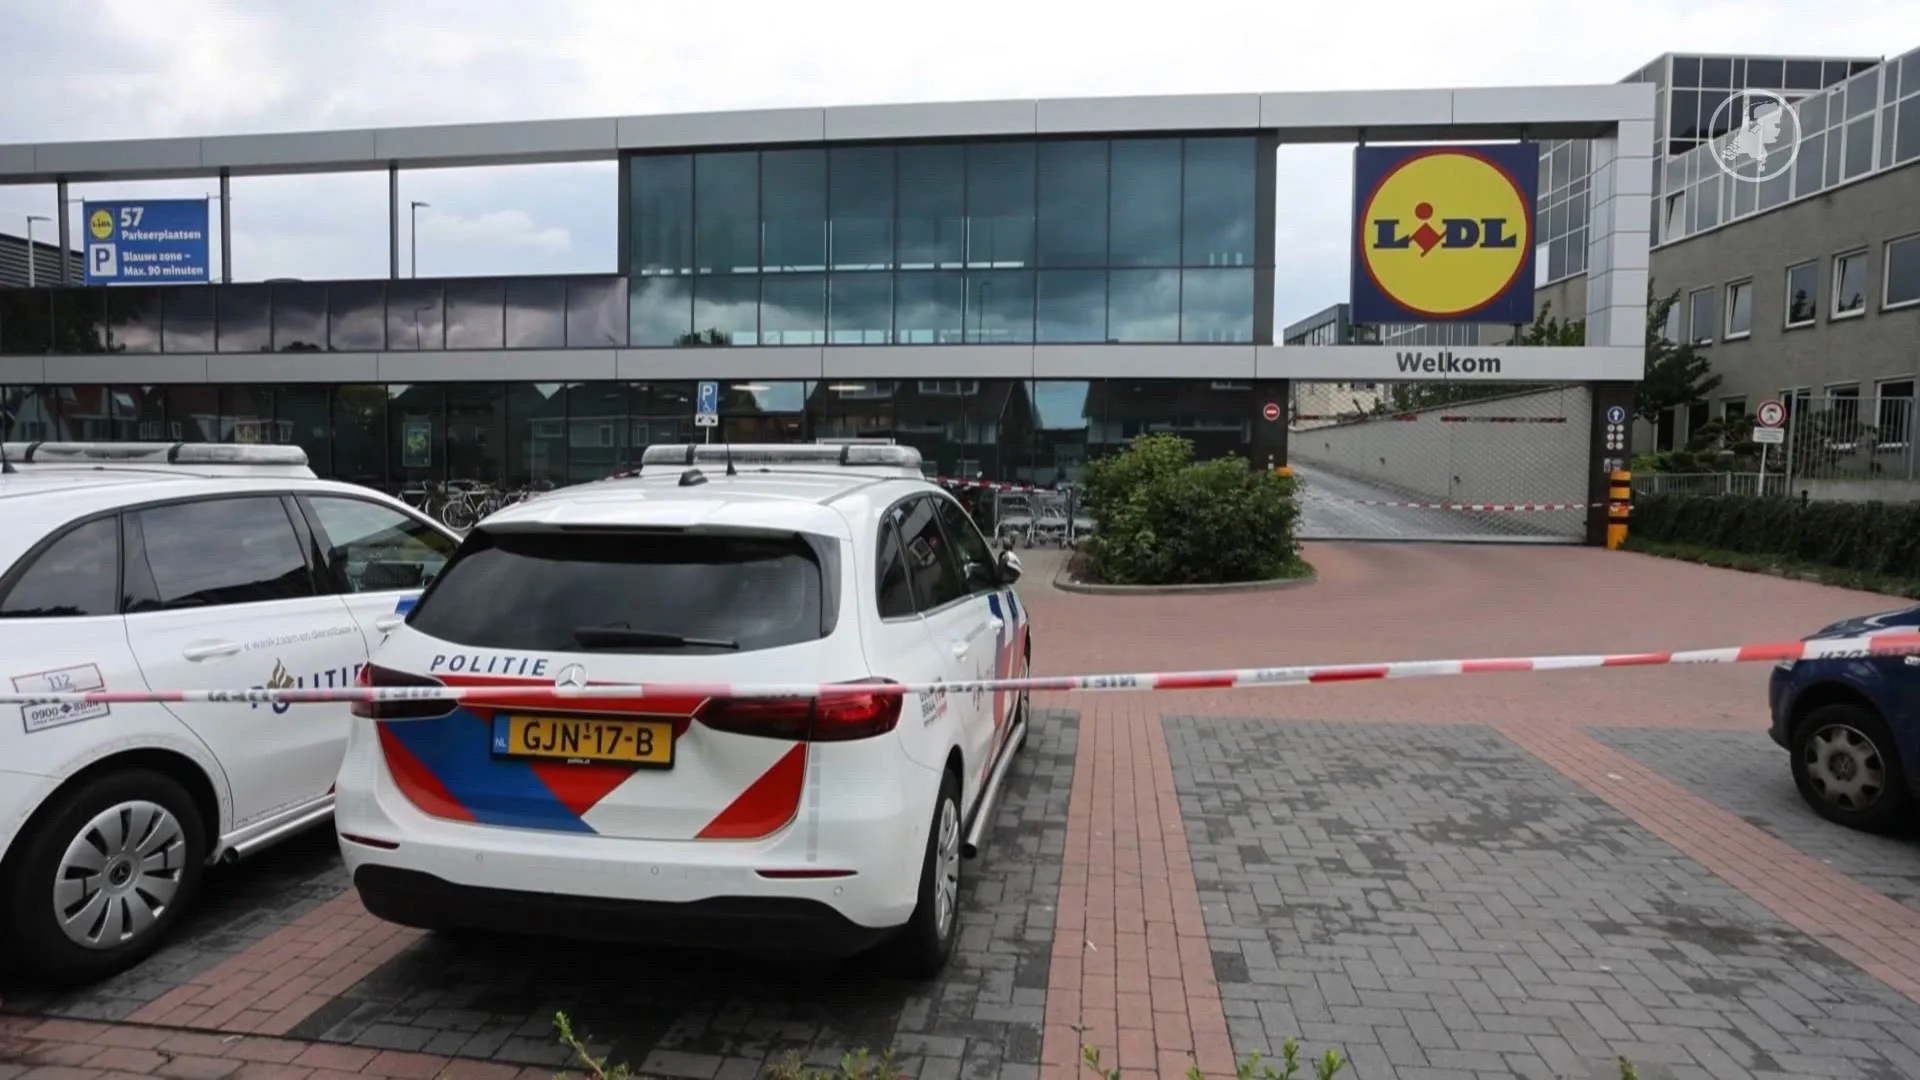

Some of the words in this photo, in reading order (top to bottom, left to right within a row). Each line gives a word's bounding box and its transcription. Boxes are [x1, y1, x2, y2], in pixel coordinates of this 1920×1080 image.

[120, 206, 144, 227] 57
[121, 230, 201, 242] Parkeerplaatsen
[95, 247, 110, 272] P
[122, 251, 158, 262] Blauwe
[159, 252, 183, 262] zone
[123, 265, 147, 276] Max.
[148, 265, 161, 276] 90
[162, 265, 203, 275] minuten
[1396, 351, 1501, 373] Welkom
[702, 385, 713, 401] P
[430, 654, 549, 677] POLITIE
[31, 706, 59, 721] 0900
[494, 737, 507, 748] NL
[523, 719, 654, 757] GJN-17-B
